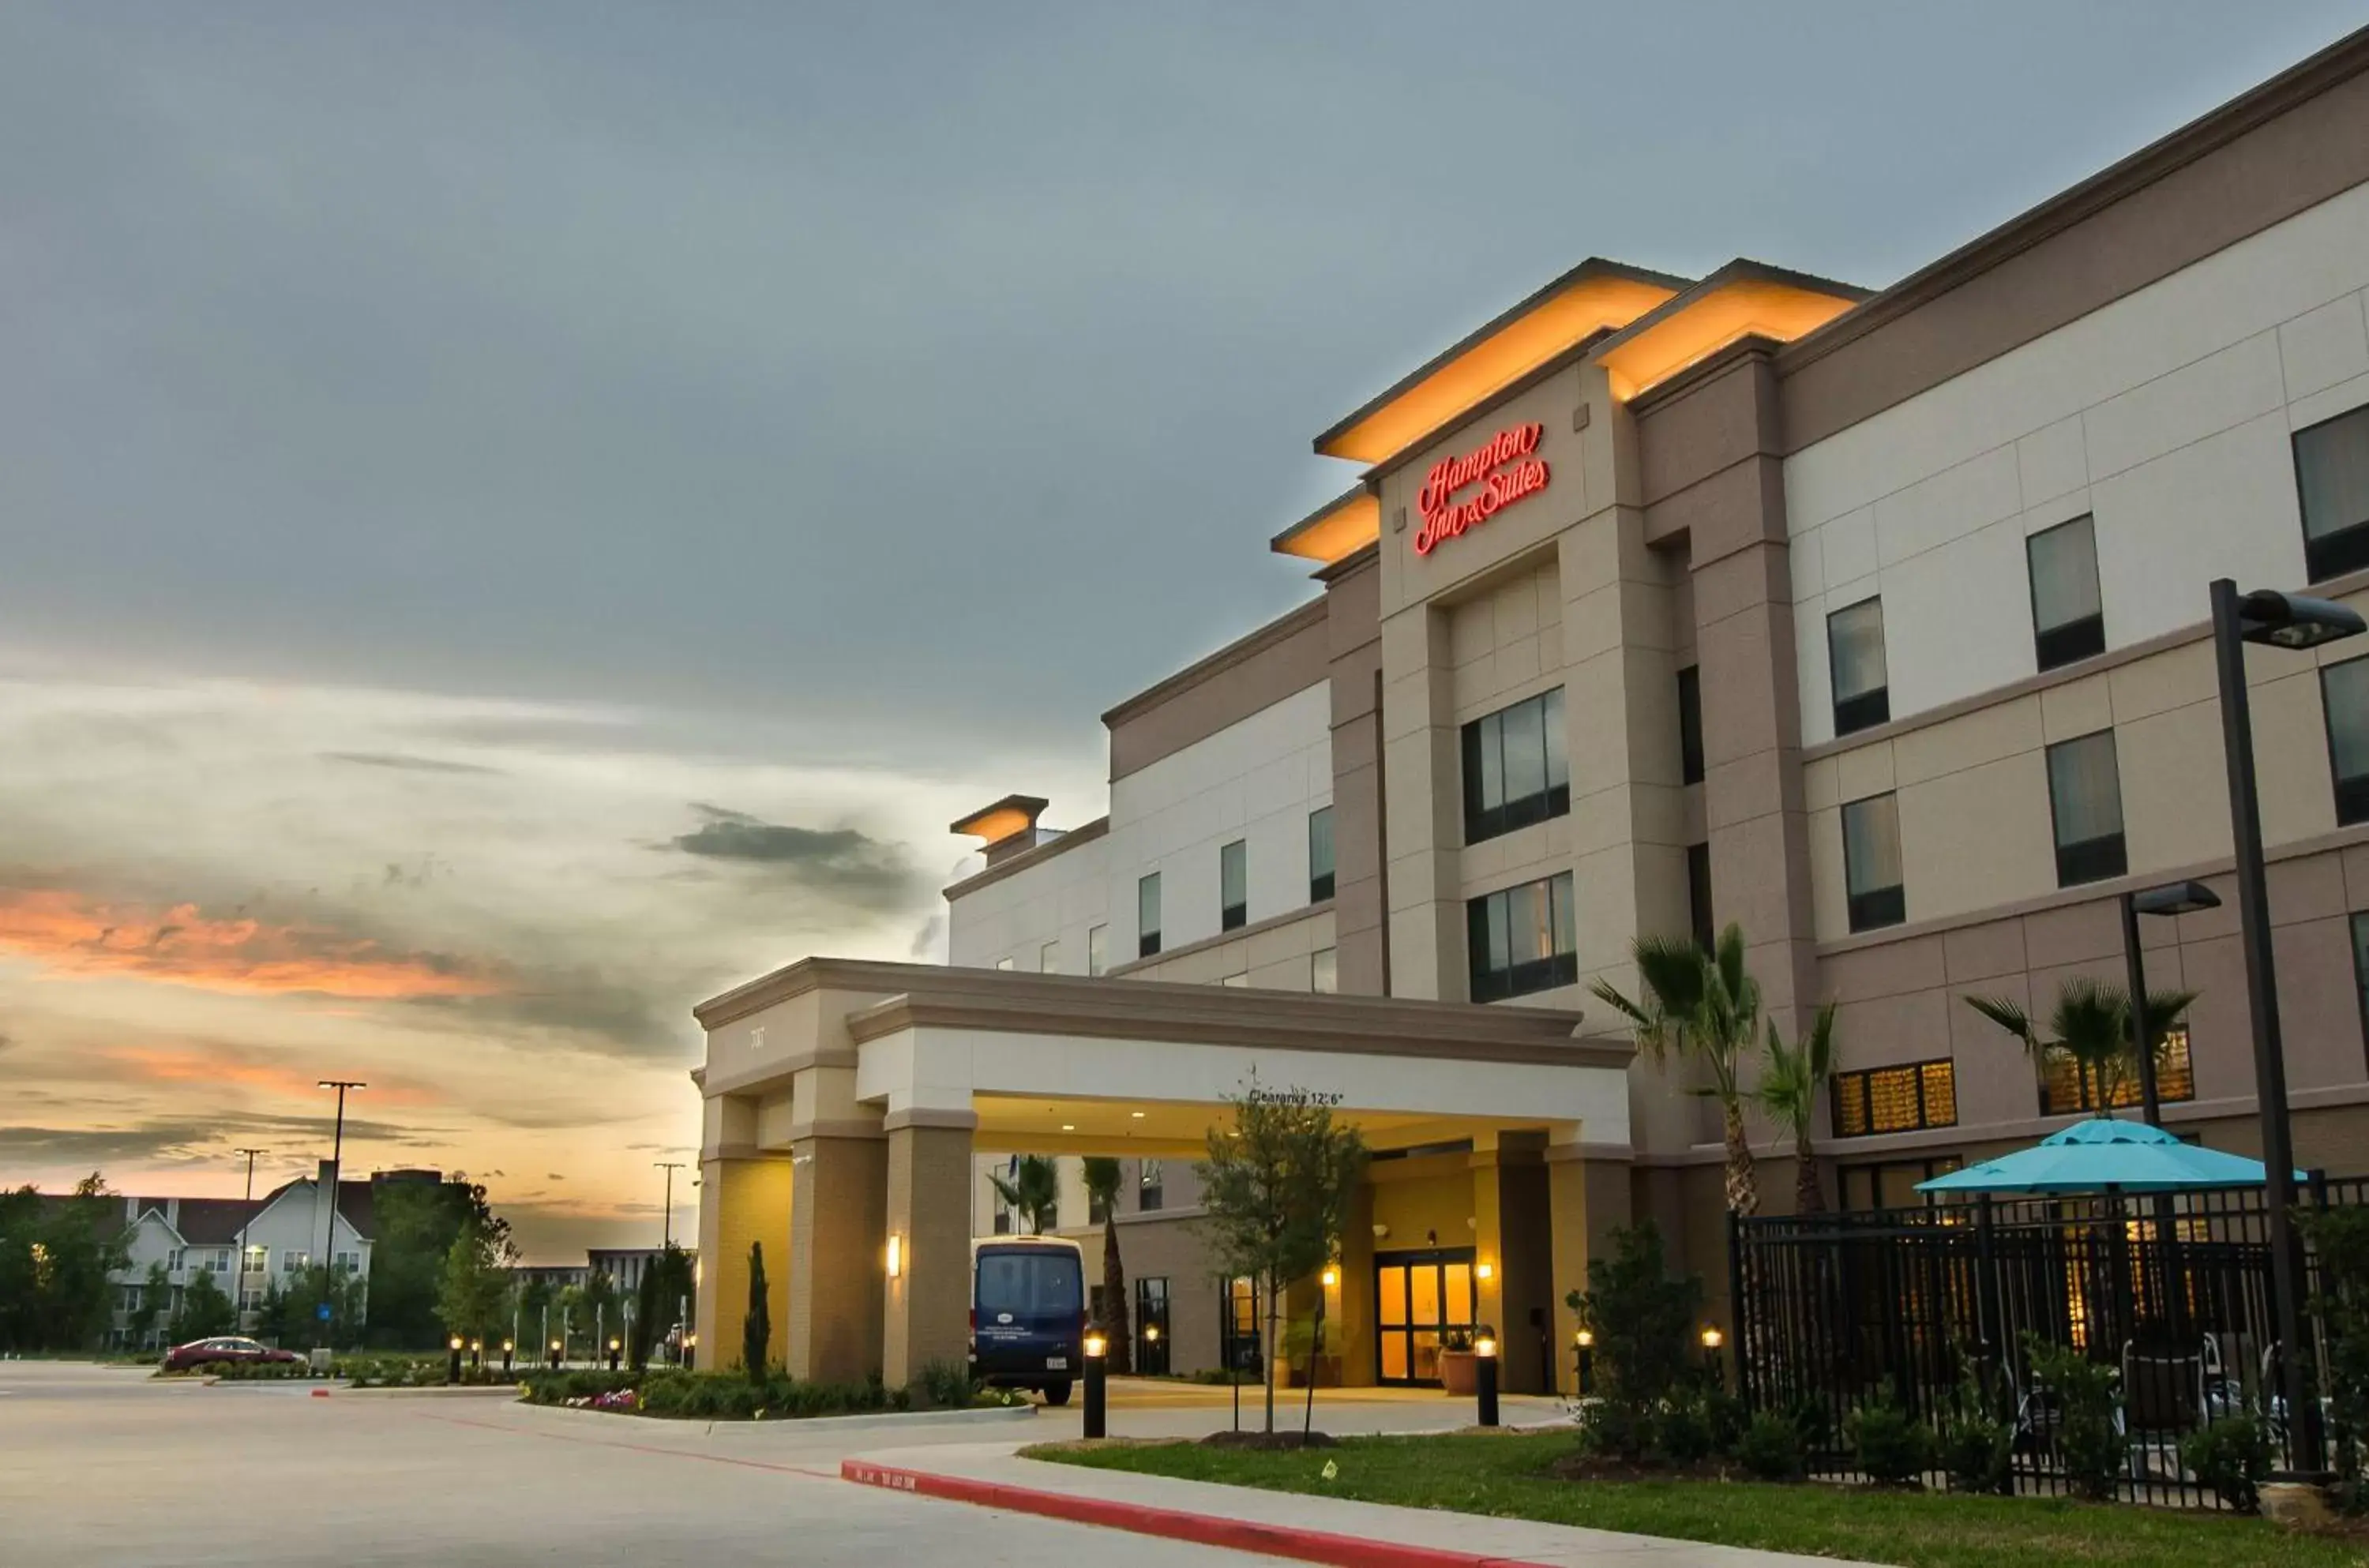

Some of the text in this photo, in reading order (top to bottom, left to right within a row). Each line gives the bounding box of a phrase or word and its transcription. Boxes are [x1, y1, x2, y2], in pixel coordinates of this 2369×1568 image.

[1416, 461, 1550, 554] Inn & Suites
[1419, 422, 1543, 516] Hampton
